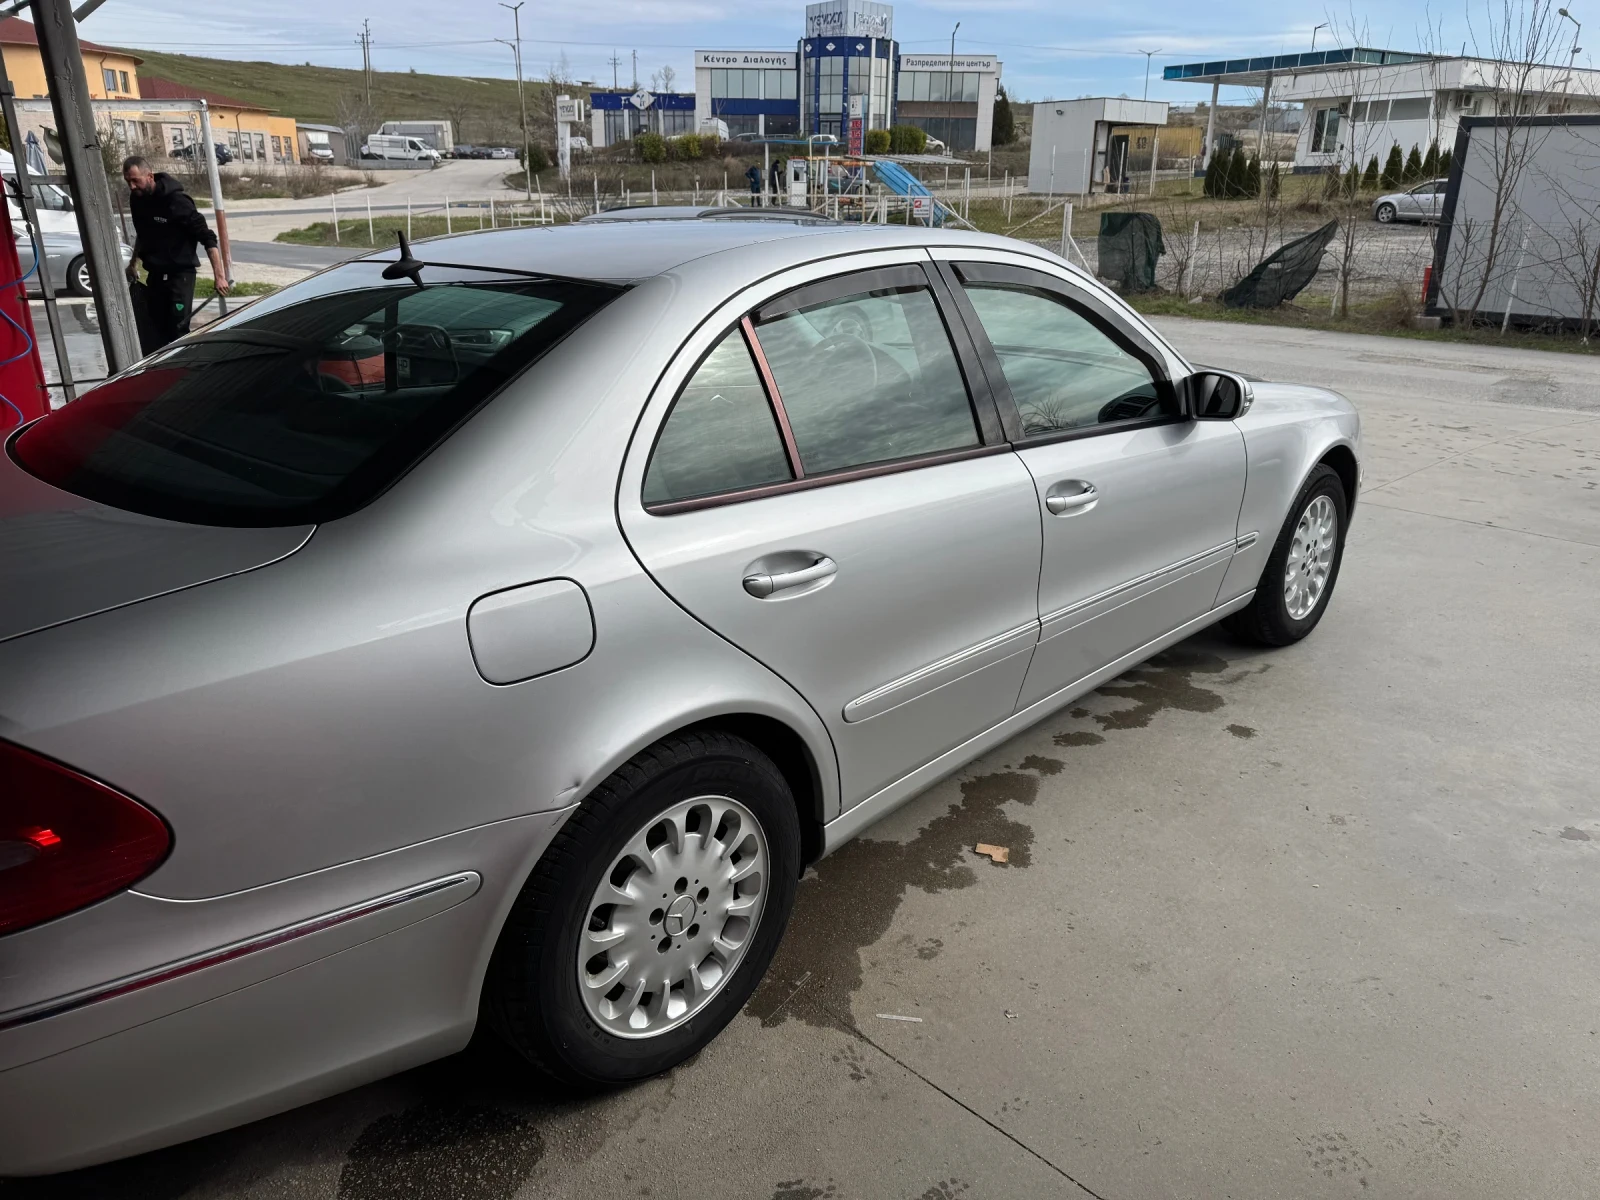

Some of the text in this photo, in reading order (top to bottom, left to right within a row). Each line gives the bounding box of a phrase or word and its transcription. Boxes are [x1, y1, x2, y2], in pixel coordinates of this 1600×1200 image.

[703, 55, 787, 65] Κέντρο Διαλογής
[906, 58, 991, 68] Разпределителен център
